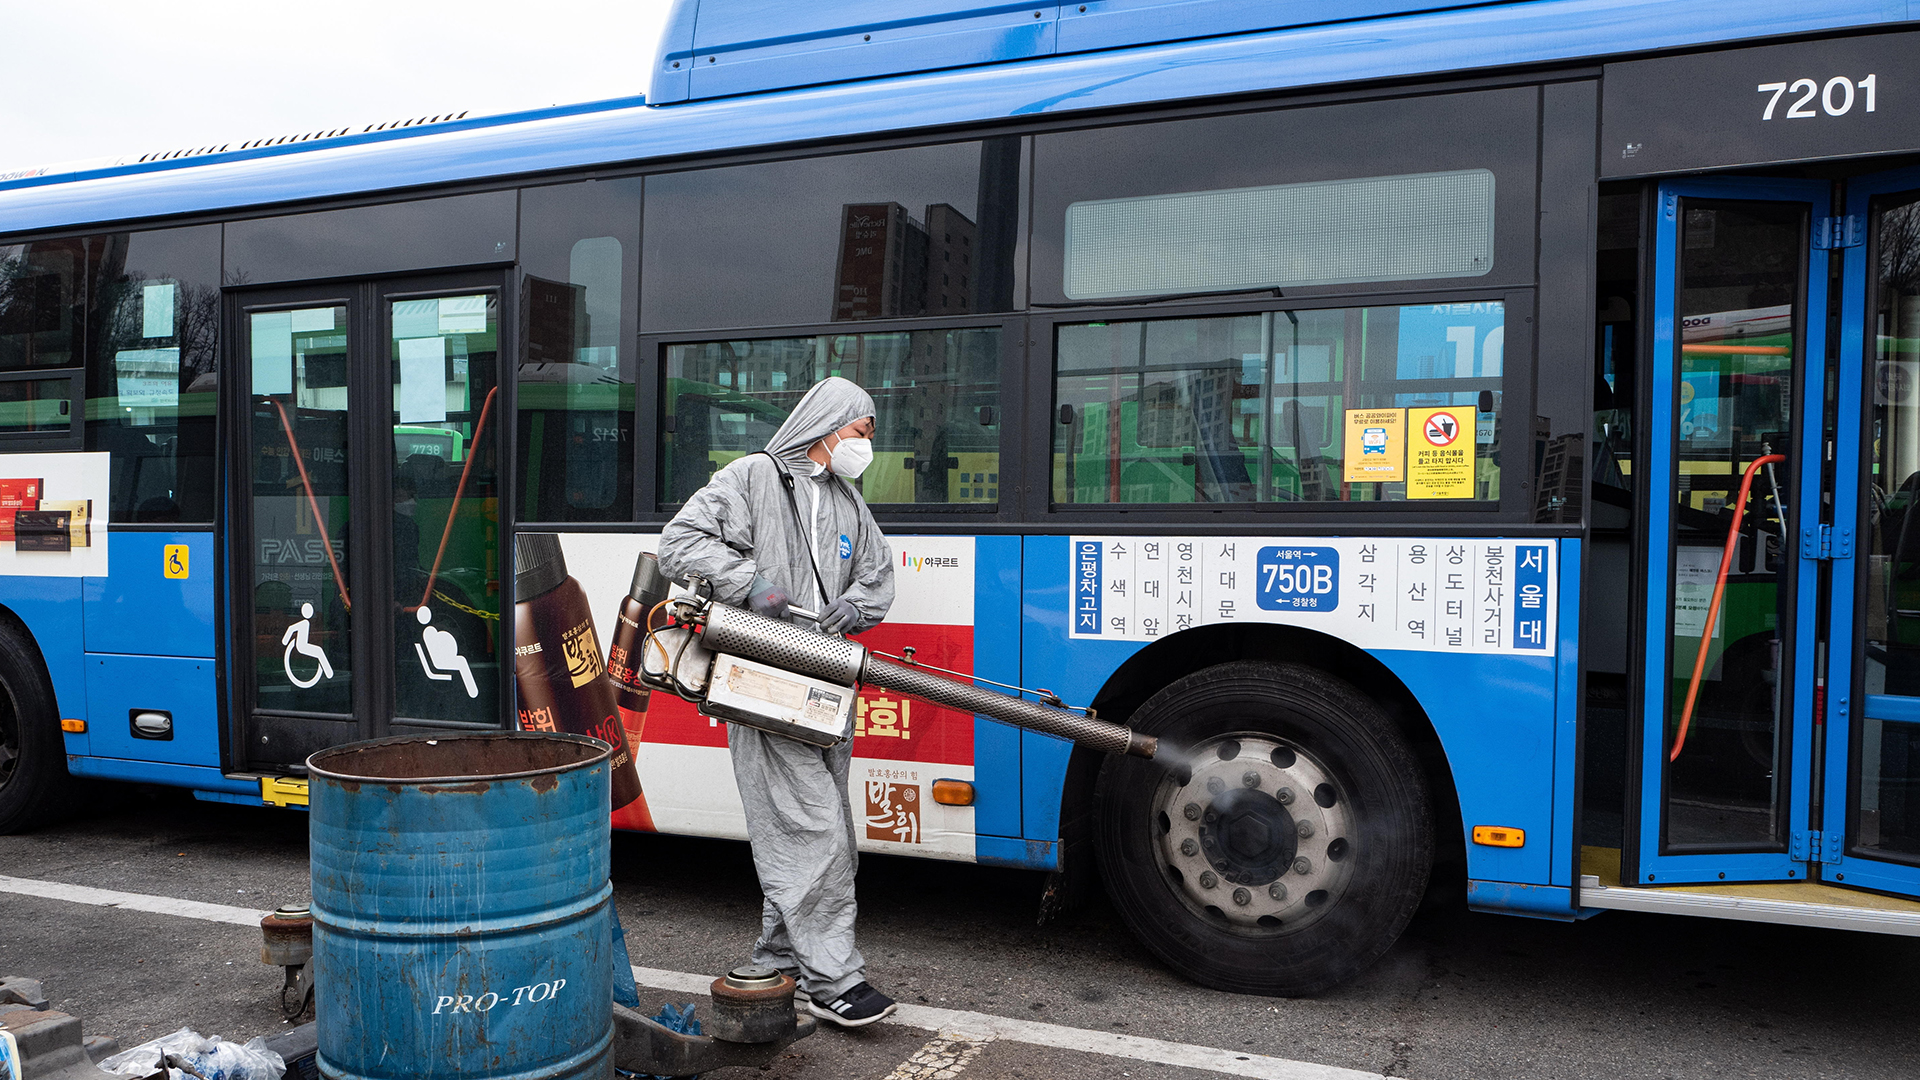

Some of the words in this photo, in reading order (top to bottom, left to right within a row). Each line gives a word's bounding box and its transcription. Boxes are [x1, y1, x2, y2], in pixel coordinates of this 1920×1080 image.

[1758, 73, 1876, 120] 7201
[313, 447, 344, 463] 이투스
[412, 444, 440, 455] 7738
[261, 539, 344, 563] PASS
[1218, 542, 1237, 619] 서대문
[1262, 564, 1333, 594] 750B
[1275, 550, 1302, 560] 서울역
[1357, 544, 1378, 623] 삼각지
[1080, 543, 1098, 630] 은평차고지
[1110, 542, 1127, 635] 수색역
[1143, 542, 1160, 636] 연대앞
[1175, 542, 1194, 631] 영천시장
[1291, 597, 1318, 608] 경찰청
[1407, 545, 1428, 640] 용산역
[1445, 545, 1466, 647] 상도터널
[1483, 545, 1505, 648] 봉천사거리
[1518, 548, 1544, 644] 서울대
[867, 768, 908, 780] 발효홍삼의
[910, 771, 918, 780] 힘
[866, 781, 919, 844] 발휘
[431, 978, 567, 1014] PRO-TOP
